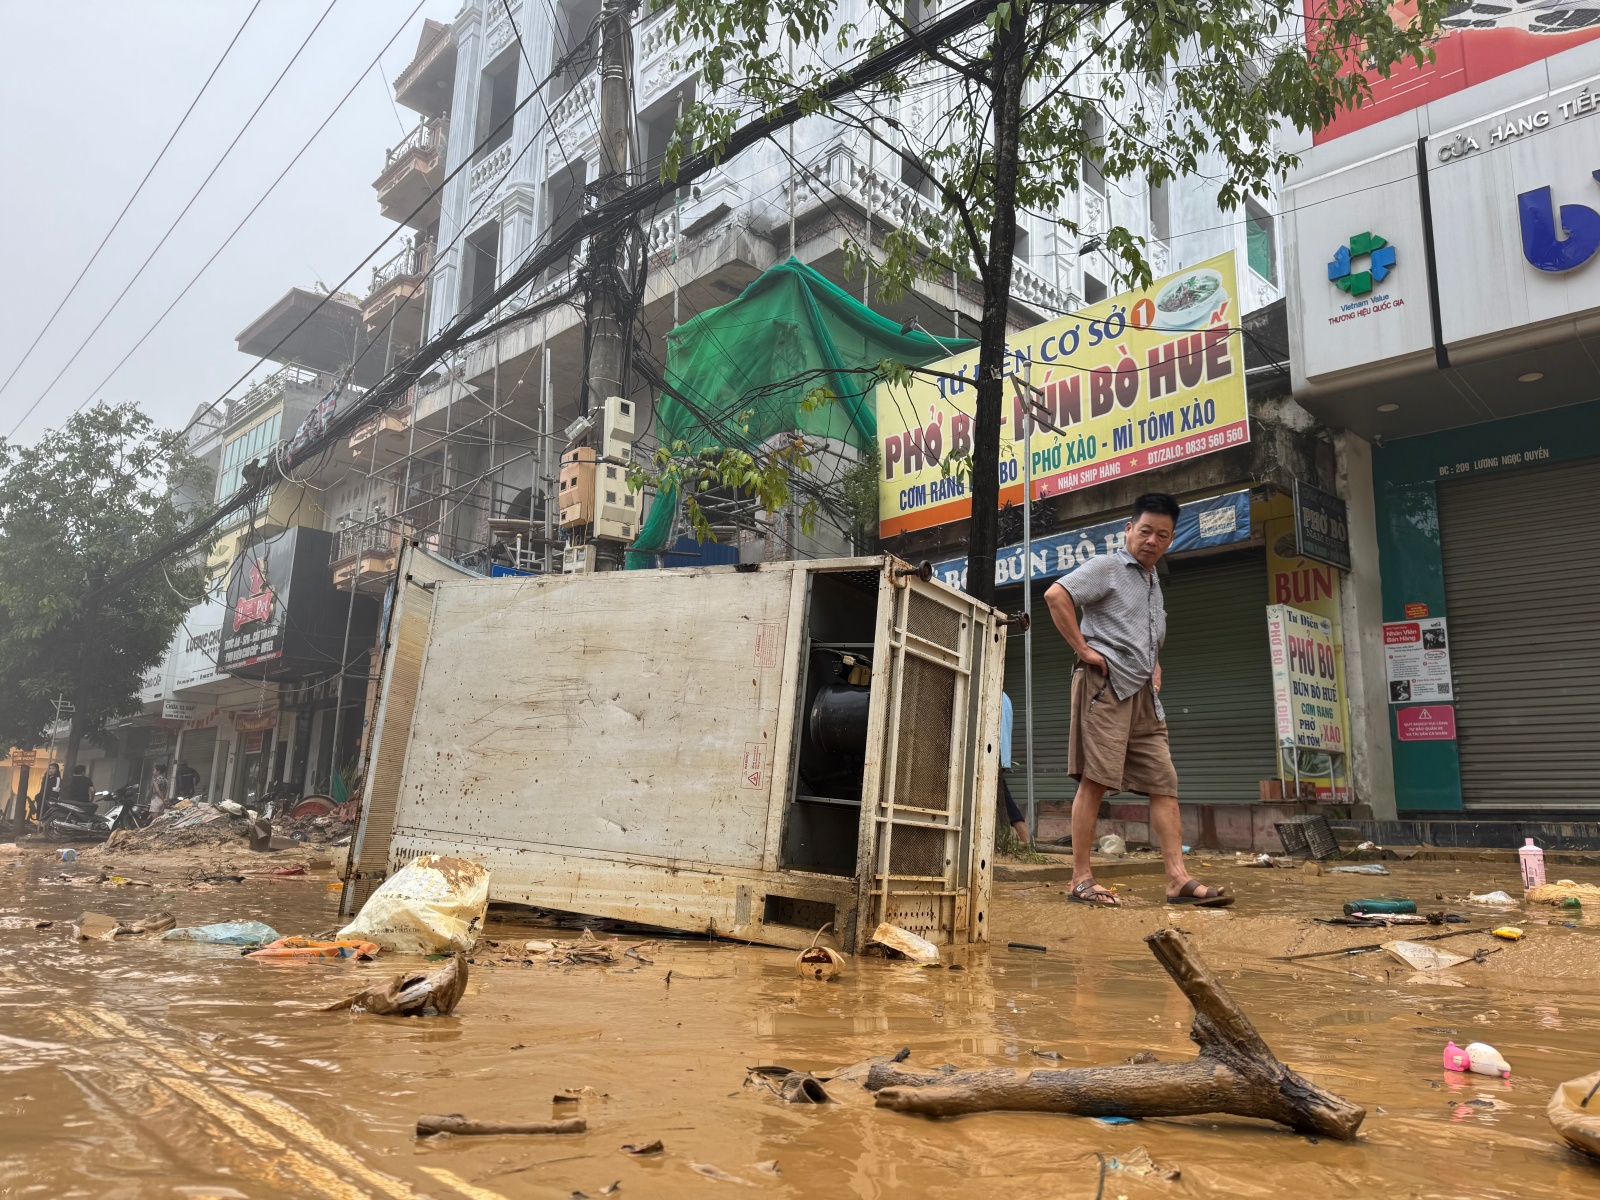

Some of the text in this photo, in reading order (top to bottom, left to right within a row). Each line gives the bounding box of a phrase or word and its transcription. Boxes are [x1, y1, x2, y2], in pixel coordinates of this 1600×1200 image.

[1437, 134, 1480, 162] CỬA
[1328, 298, 1405, 326] THƯƠNG HIỆU QUỐC GIA
[1340, 294, 1390, 313] Vietnam Value
[1040, 324, 1081, 363] CƠ
[1088, 304, 1127, 347] SỞ
[884, 404, 944, 480] PHỞ
[951, 398, 976, 458] B
[1089, 344, 1140, 419] BÒ
[1146, 299, 1234, 401] HUẾ
[899, 484, 927, 511] CƠM
[1000, 453, 1018, 484] BÒ
[1031, 435, 1063, 476] PHỞ
[1066, 432, 1097, 466] XÀO
[1112, 416, 1133, 453] MÌ
[1138, 411, 1175, 444] TÔM
[1180, 397, 1216, 433] XÀO
[1058, 426, 1244, 491] NHẬN SHIP HÀNG ĐT/ZALO: 0833 560 560
[1455, 463, 1470, 473] 209
[1474, 457, 1499, 470] LƯƠNG
[1501, 453, 1522, 465] NGỌC
[1301, 506, 1347, 542] PHỞ BÒ
[995, 547, 1048, 584] BÚN
[1274, 559, 1333, 605] BÚN
[1288, 629, 1335, 682] PHỞ BÒ
[1292, 678, 1338, 703] BÚN BÒ HUẾ
[1301, 702, 1334, 720] CƠM RANG
[1306, 733, 1321, 747] TÔM
[1322, 722, 1342, 744] XÀO
